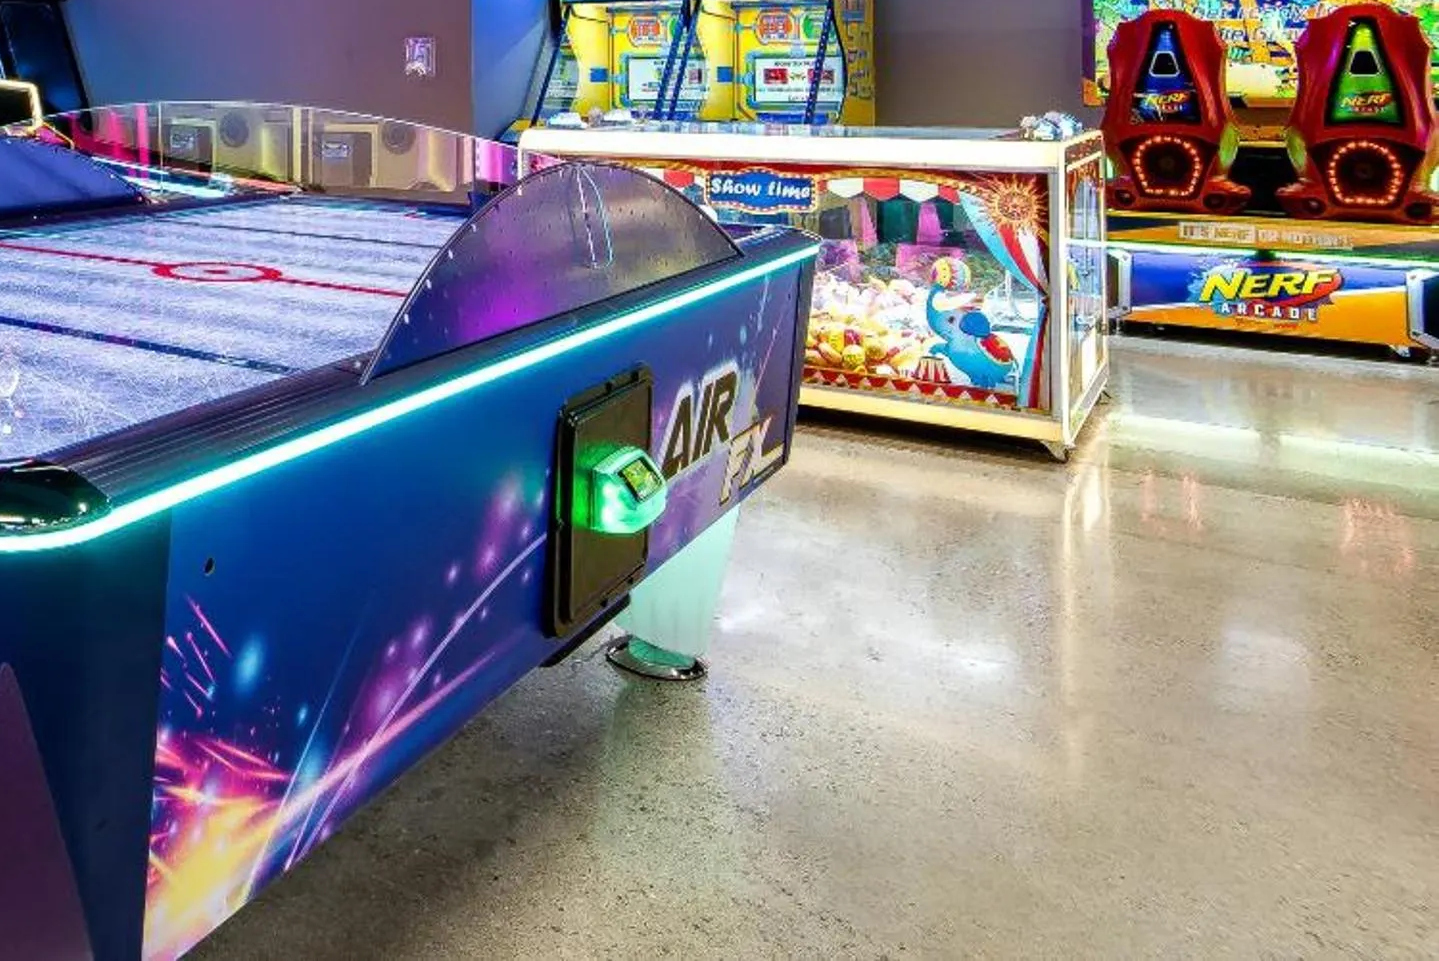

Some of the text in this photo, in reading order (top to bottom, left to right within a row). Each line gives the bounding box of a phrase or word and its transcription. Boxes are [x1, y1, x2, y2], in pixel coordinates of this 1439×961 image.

[711, 178, 762, 196] Show
[1199, 269, 1341, 303] NERF
[1221, 302, 1318, 322] ARCADE
[662, 370, 737, 477] AIR
